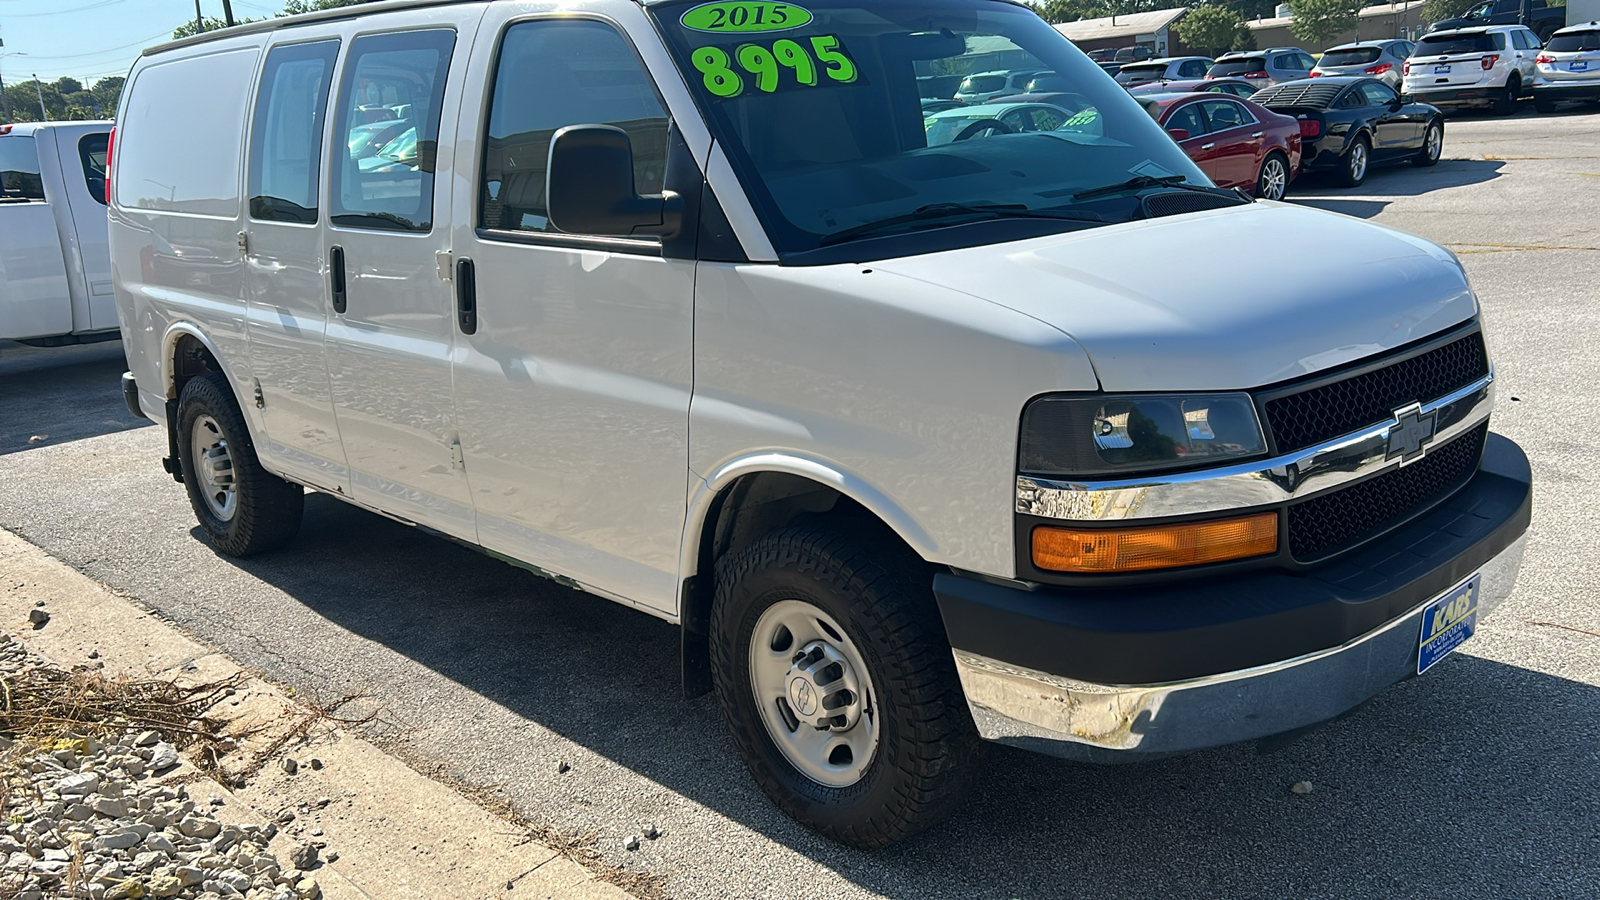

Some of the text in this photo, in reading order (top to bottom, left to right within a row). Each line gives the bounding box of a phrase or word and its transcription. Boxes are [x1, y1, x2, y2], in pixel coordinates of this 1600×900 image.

[708, 5, 788, 29] 2015
[691, 35, 858, 98] 8995
[1430, 589, 1472, 636] KARS
[1426, 616, 1471, 653] INCORPORATED
